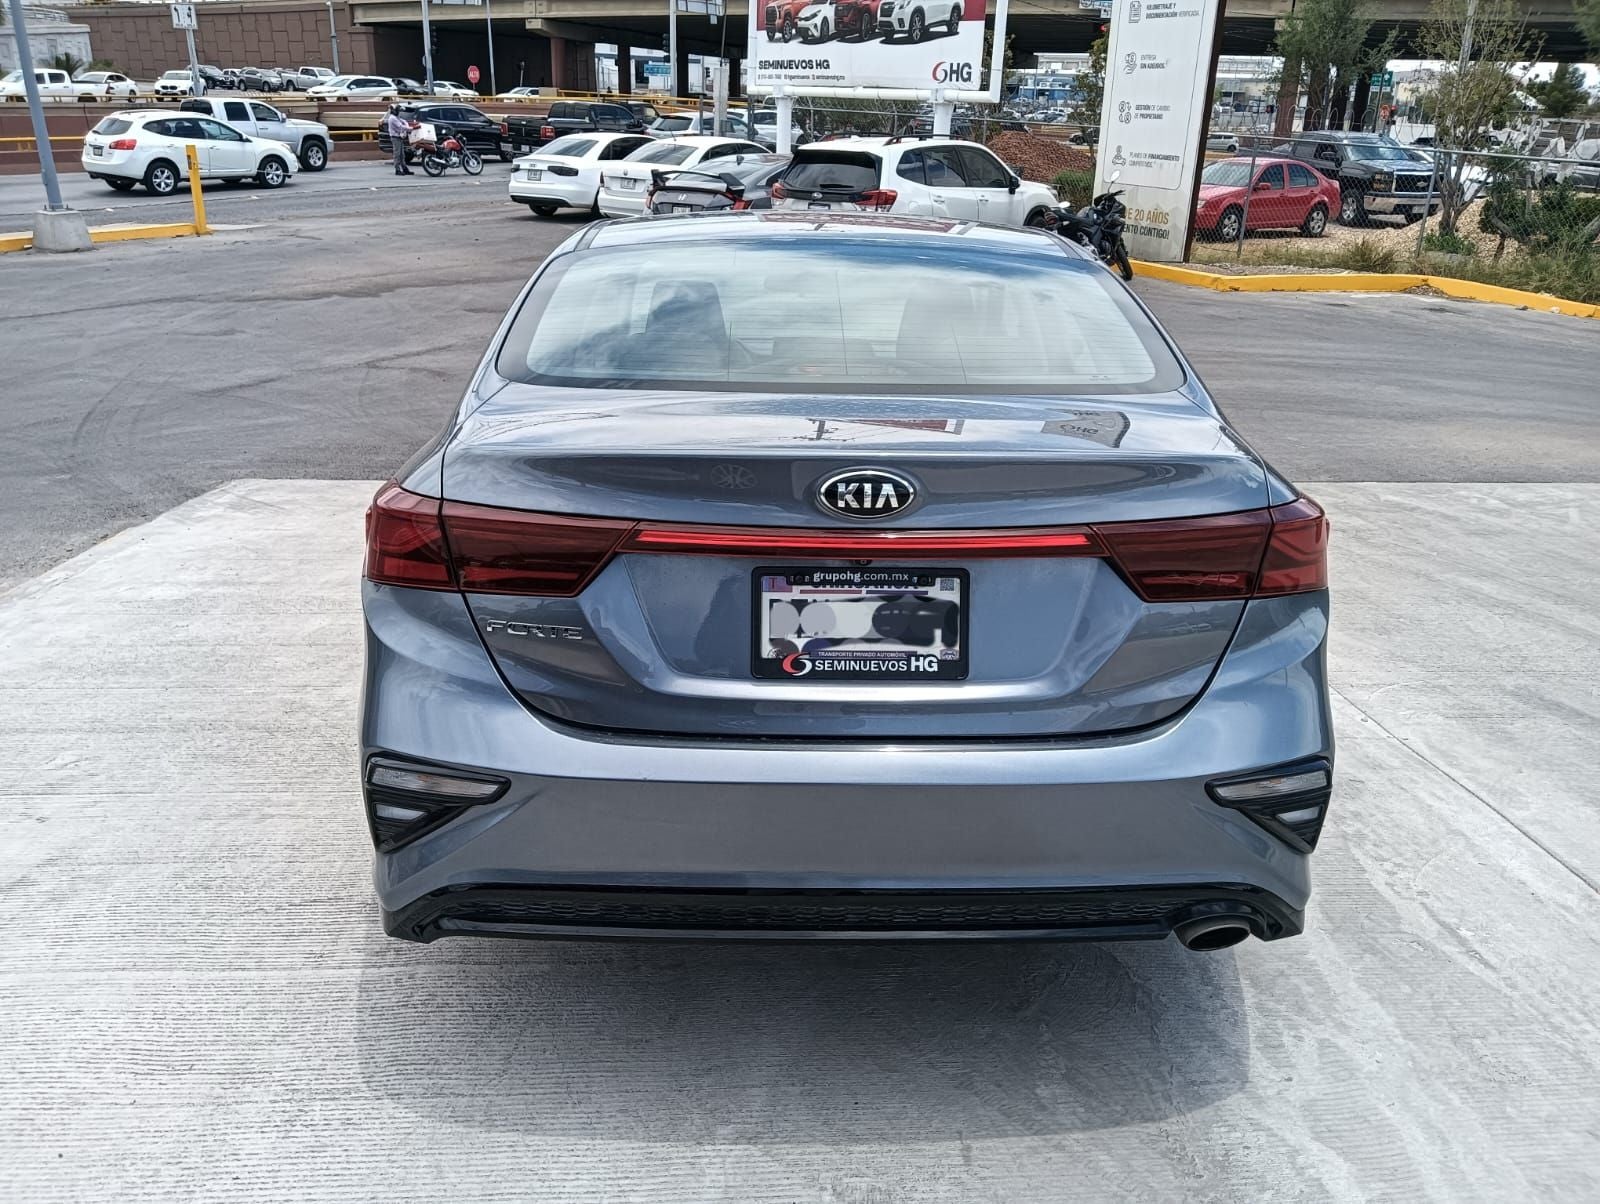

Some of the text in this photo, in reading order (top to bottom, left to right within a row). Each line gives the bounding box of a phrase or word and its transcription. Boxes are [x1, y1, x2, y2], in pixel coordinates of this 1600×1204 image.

[758, 59, 830, 70] SEMINUEVOS HG
[949, 62, 972, 82] HG
[1134, 208, 1145, 221] 20
[1146, 208, 1170, 225] AÑOS
[1123, 224, 1170, 240] ENTO CONTIGO!
[837, 482, 899, 509] KIA
[813, 571, 909, 583] grupohg.com.mx
[486, 619, 583, 640] FORTE
[815, 656, 939, 672] SEMINUEVOS HG
